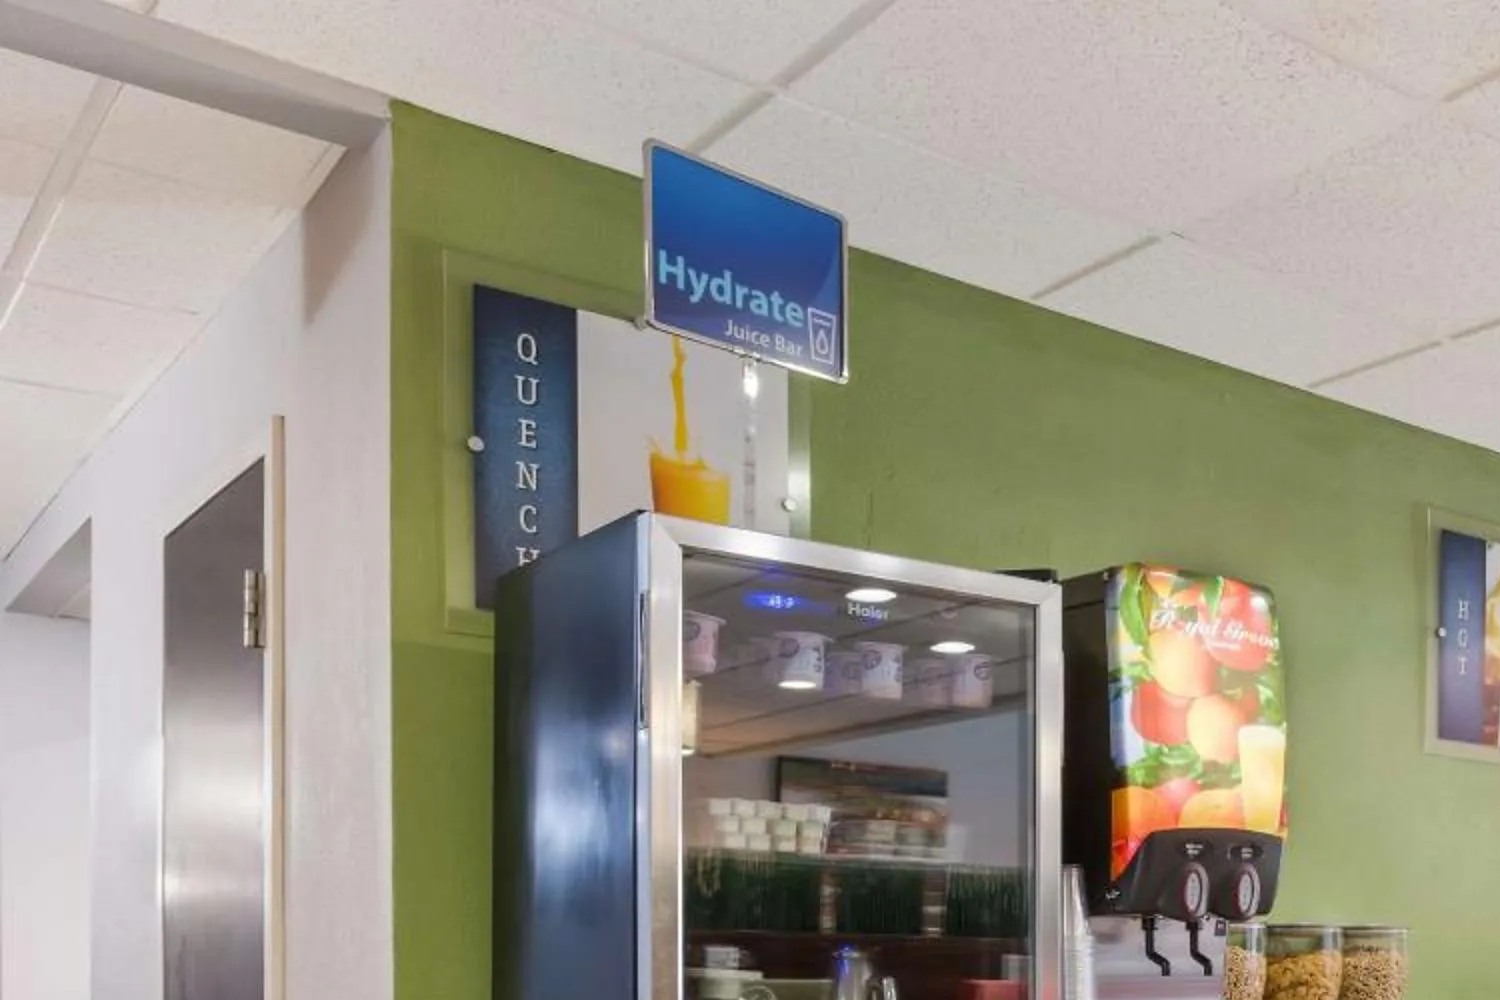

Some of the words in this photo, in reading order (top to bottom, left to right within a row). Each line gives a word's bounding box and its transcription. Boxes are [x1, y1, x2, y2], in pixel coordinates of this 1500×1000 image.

[658, 249, 804, 328] Hydrate
[724, 318, 770, 348] Juice
[775, 334, 804, 356] Bar
